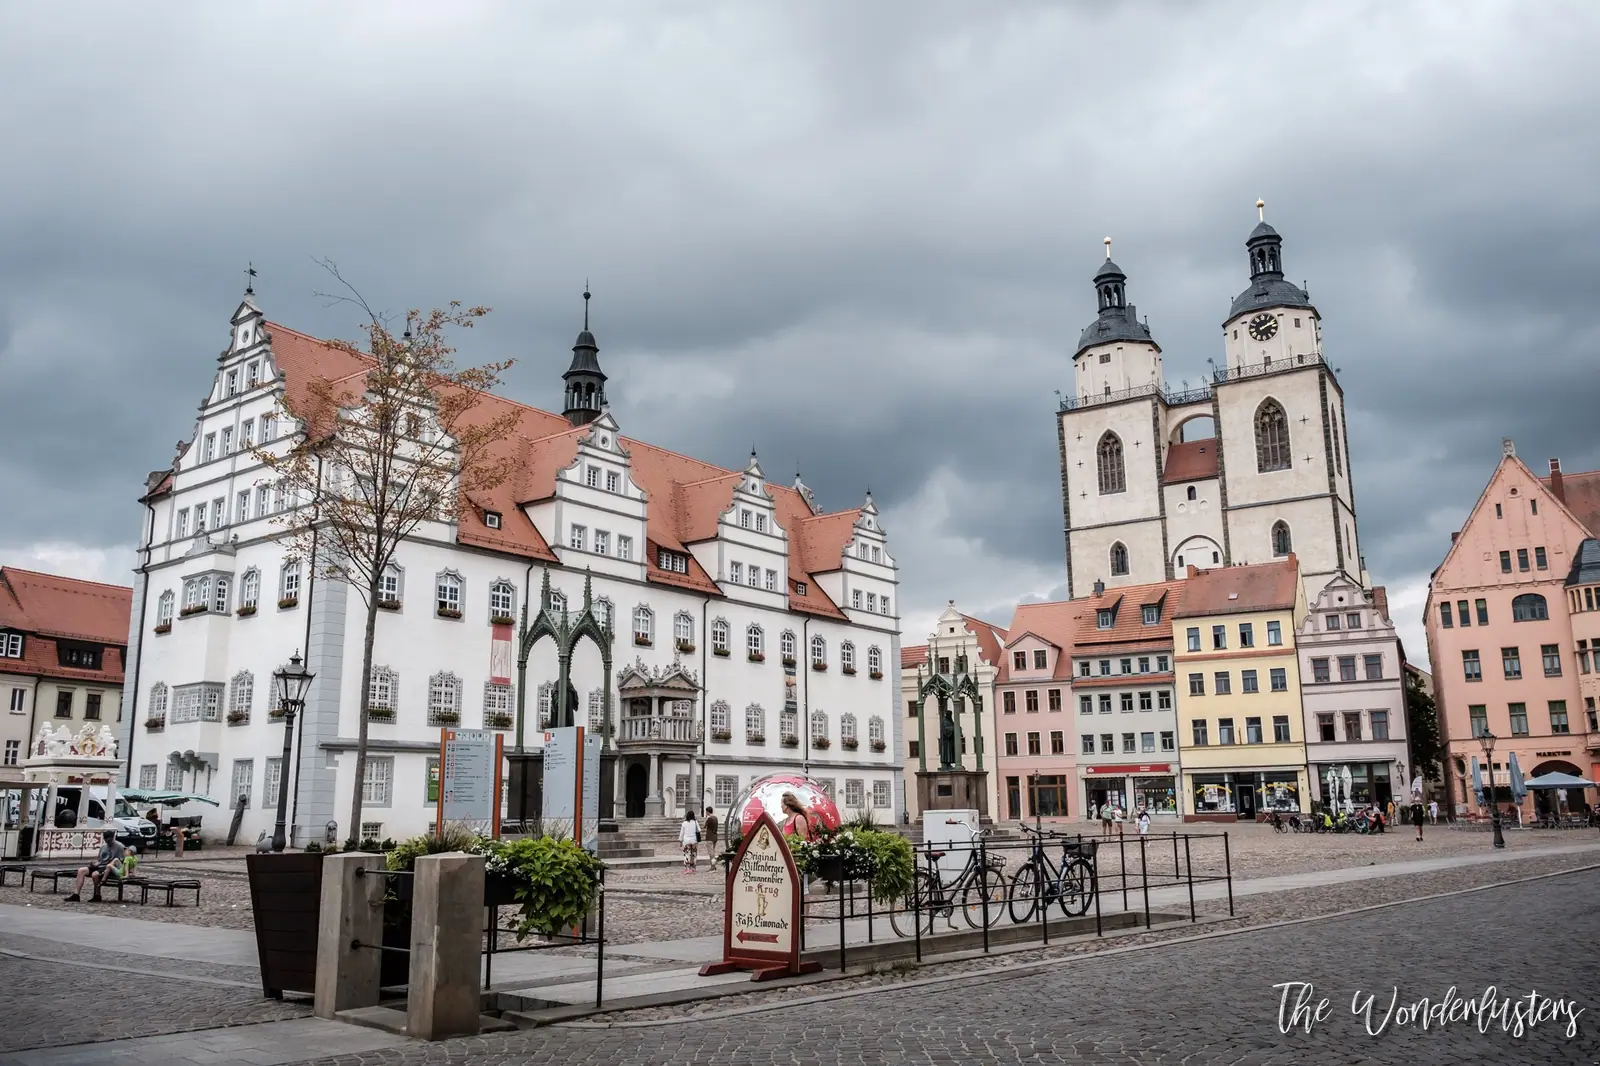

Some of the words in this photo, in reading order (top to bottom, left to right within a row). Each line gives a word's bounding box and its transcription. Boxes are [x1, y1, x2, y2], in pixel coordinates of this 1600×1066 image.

[744, 851, 777, 862] Original
[739, 858, 784, 874] Wittenberger
[745, 884, 753, 892] im
[755, 883, 779, 897] Krug
[754, 914, 789, 930] Limonade
